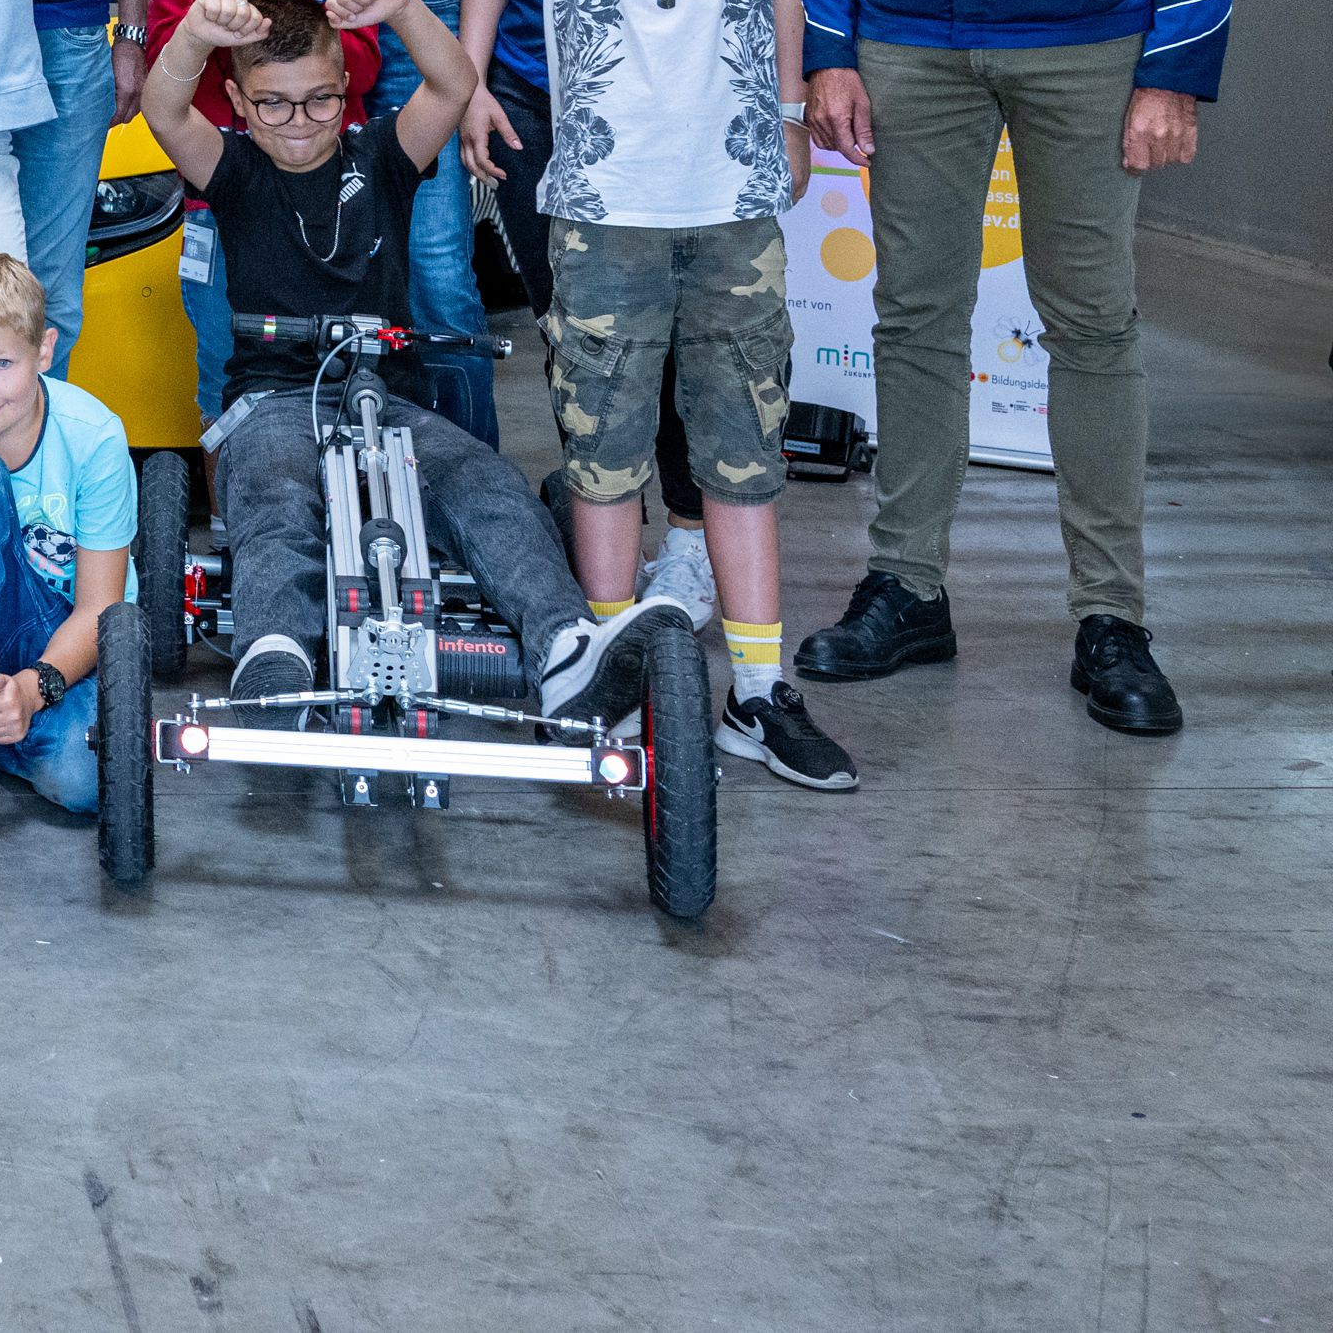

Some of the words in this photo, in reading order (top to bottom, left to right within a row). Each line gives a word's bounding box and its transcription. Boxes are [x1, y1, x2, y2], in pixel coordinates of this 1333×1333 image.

[811, 302, 832, 314] von
[843, 370, 876, 379] ZUKUNF
[438, 638, 506, 654] infento
